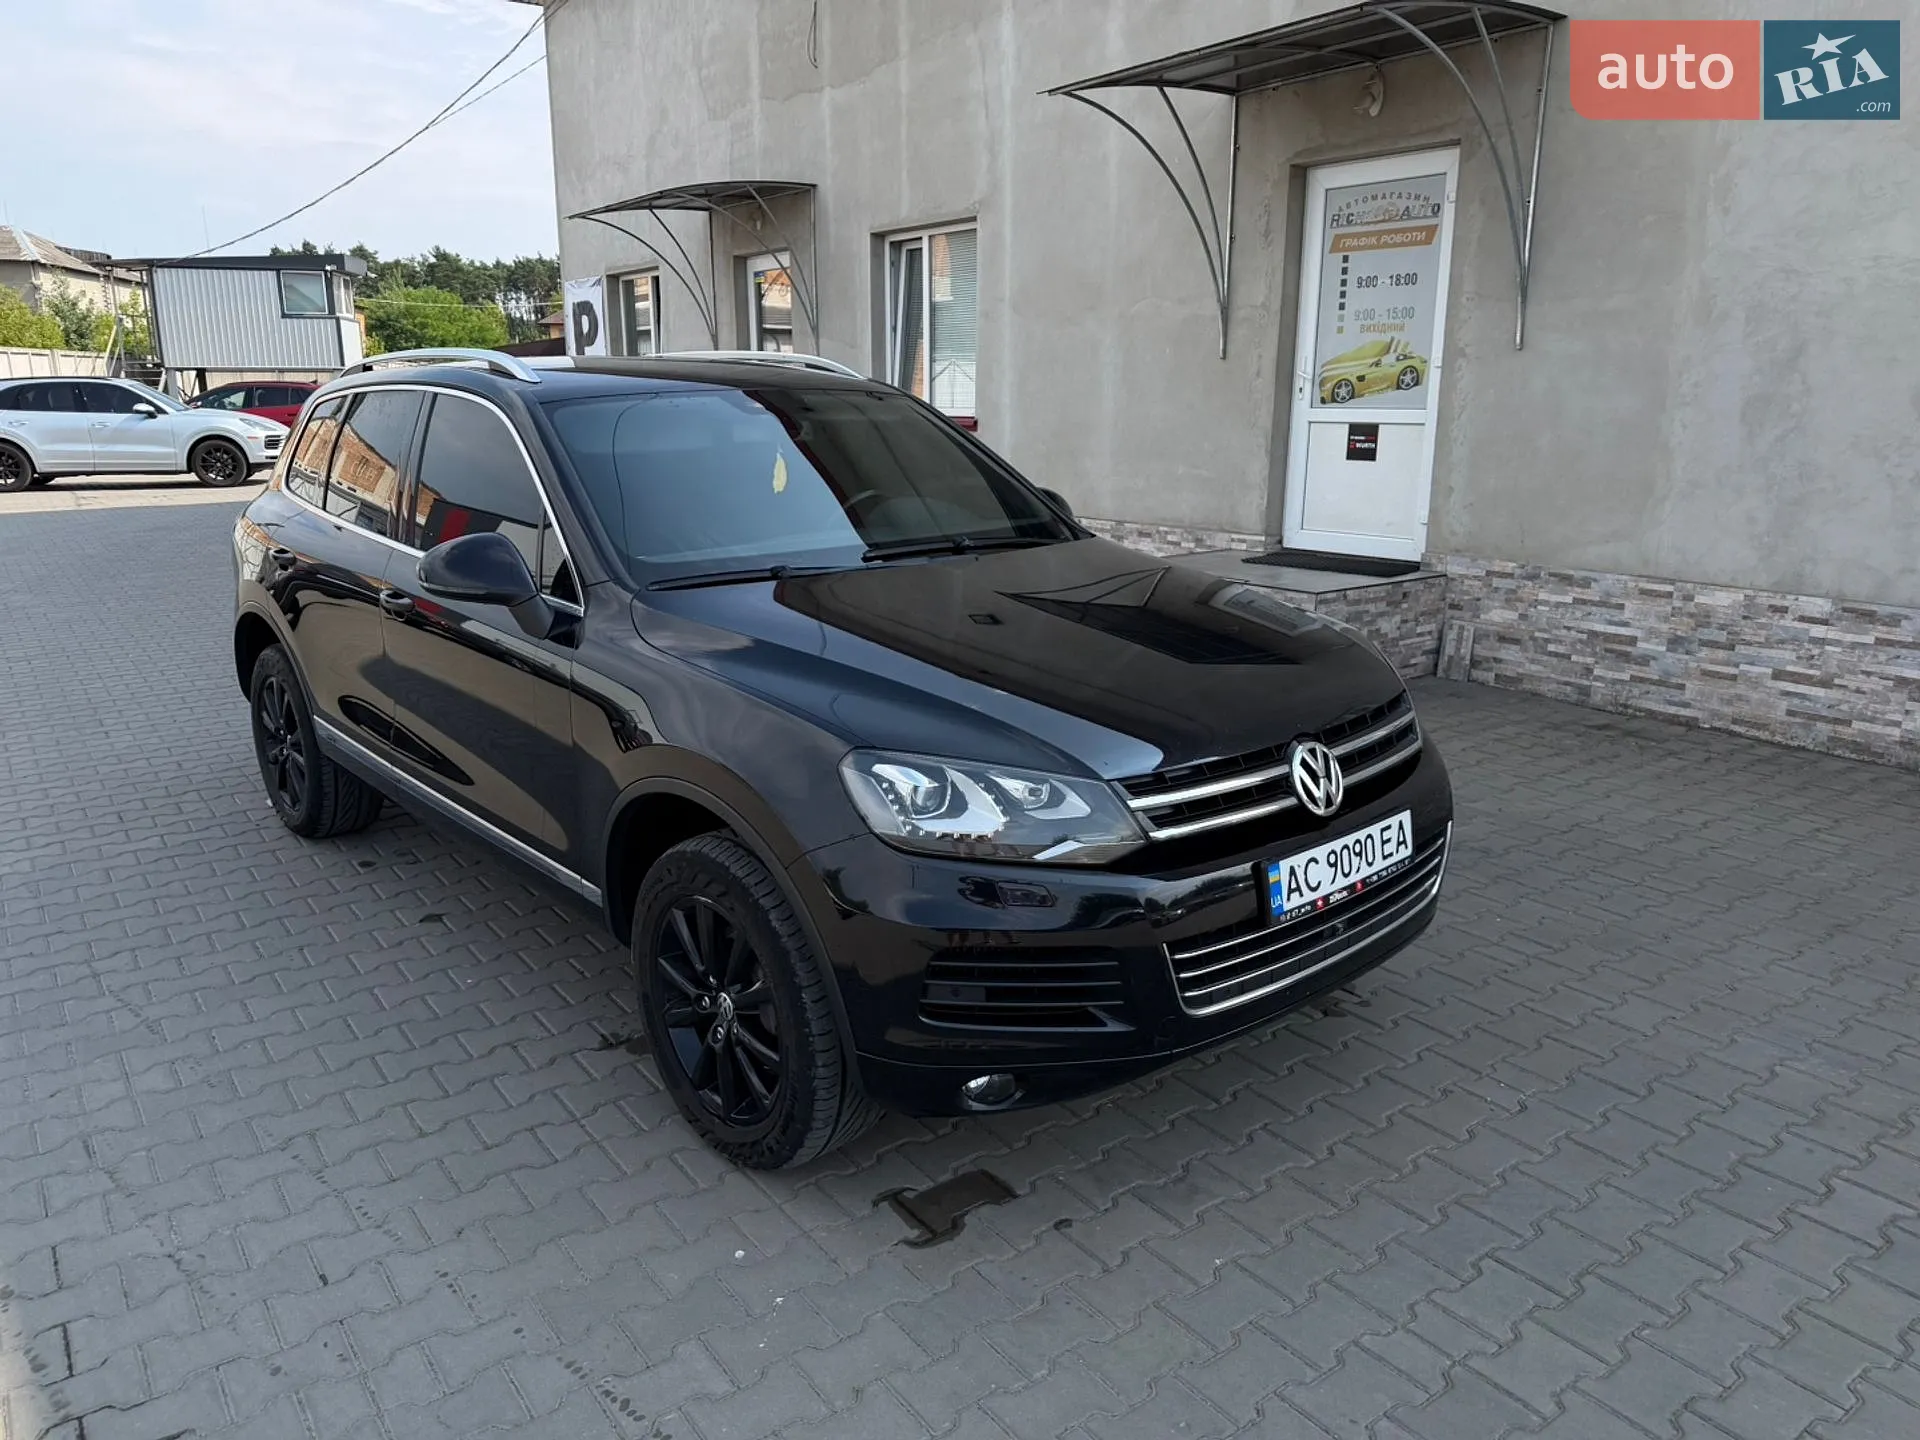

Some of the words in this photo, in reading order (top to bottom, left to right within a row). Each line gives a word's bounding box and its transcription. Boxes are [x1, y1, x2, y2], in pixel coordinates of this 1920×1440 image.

[1340, 236, 1378, 249] ГРАФІК
[1380, 231, 1427, 246] РОБОТИ
[1356, 275, 1379, 288] 9:00
[1389, 272, 1418, 287] 18:00
[1354, 308, 1376, 321] 9:00
[1386, 306, 1415, 320] 15:00
[1271, 895, 1283, 908] UA
[1286, 857, 1322, 902] AC
[1326, 833, 1375, 885] 9090
[1380, 820, 1408, 860] EA
